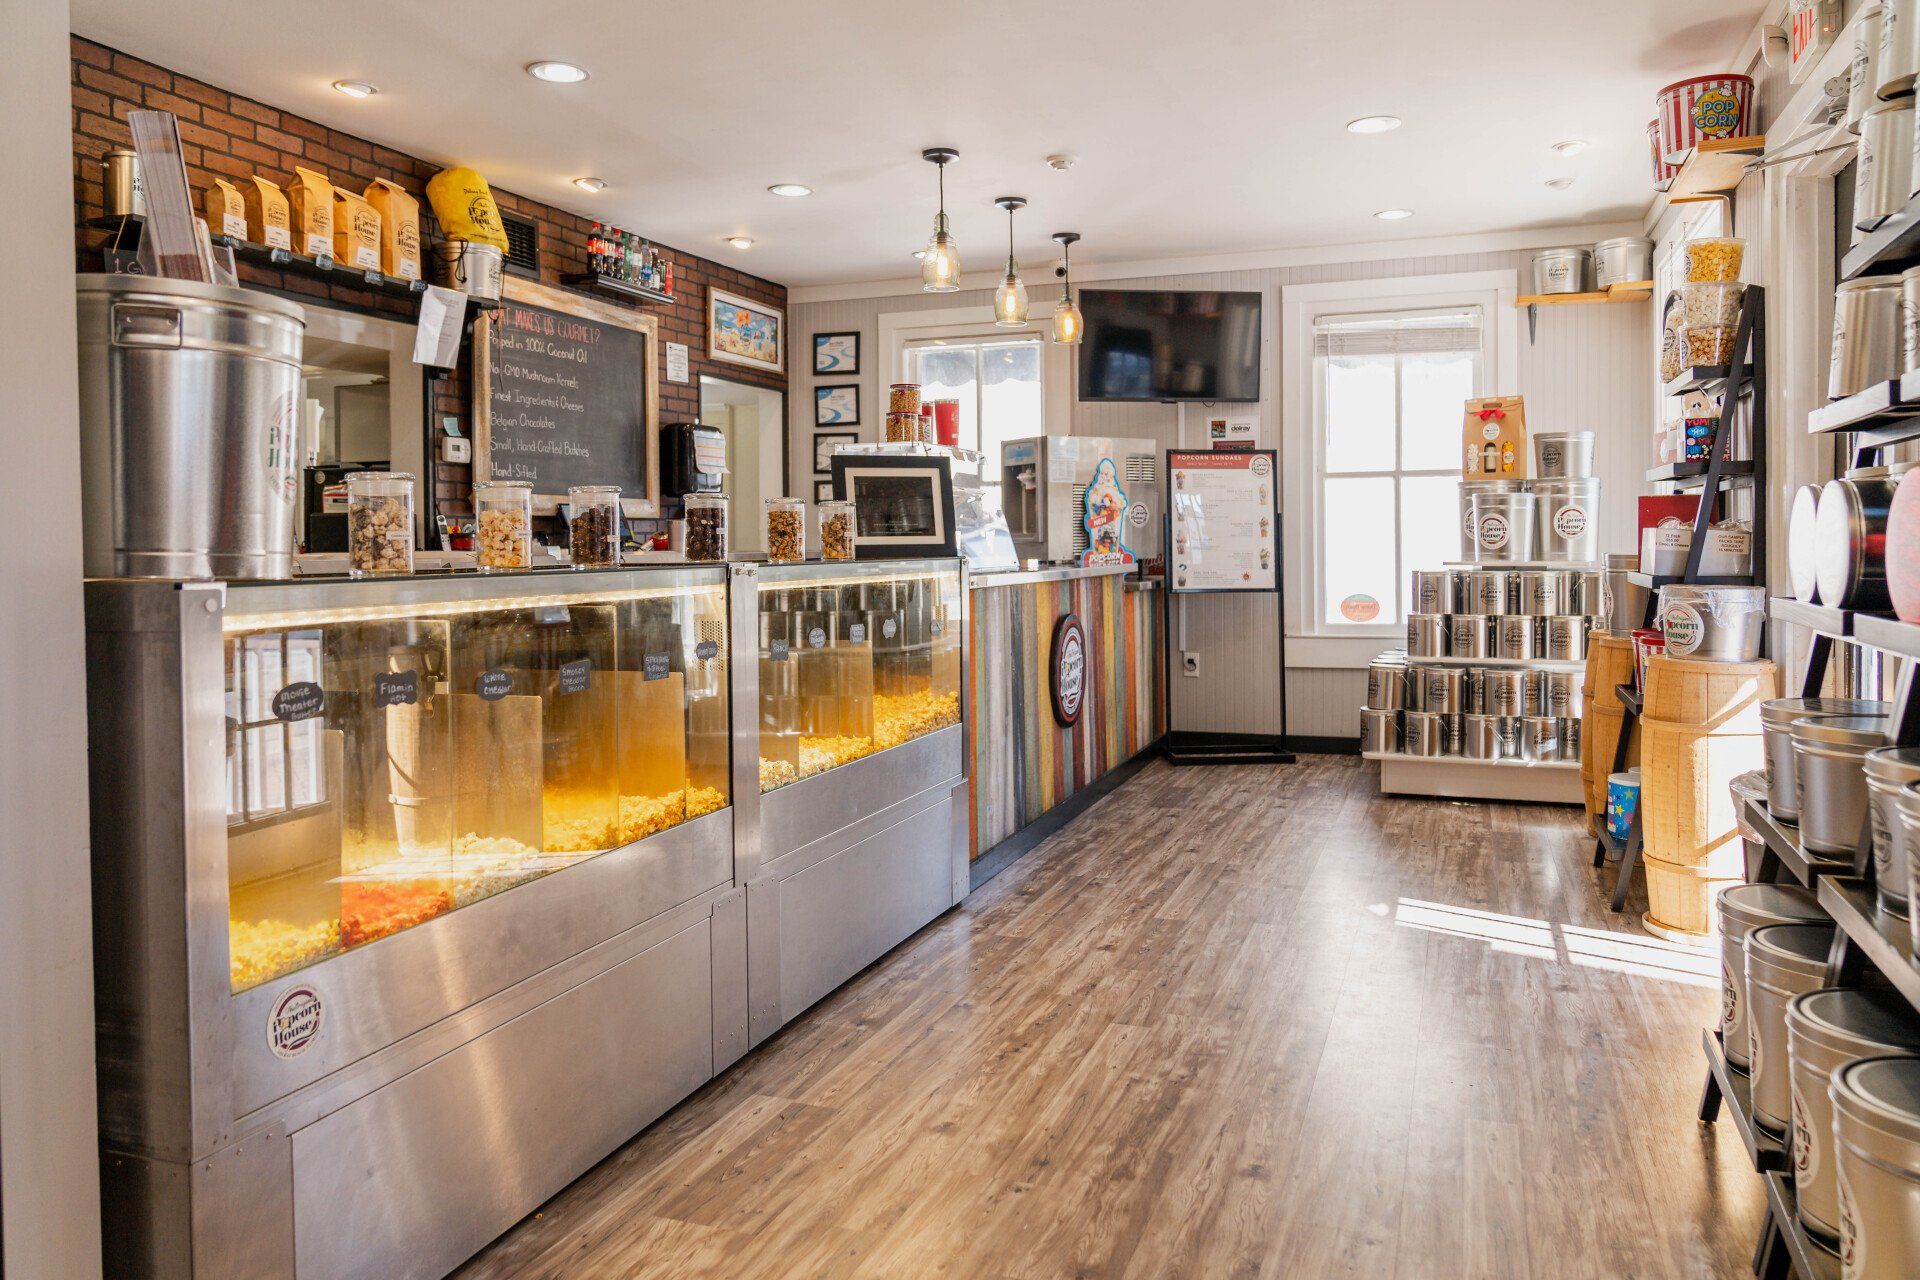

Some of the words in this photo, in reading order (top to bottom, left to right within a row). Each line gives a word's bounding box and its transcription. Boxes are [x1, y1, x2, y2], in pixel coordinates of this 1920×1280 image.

[1793, 8, 1814, 64] EXIT
[1702, 100, 1734, 114] POP
[1694, 114, 1738, 129] CORN
[515, 309, 540, 333] MAKES
[543, 315, 555, 336] US
[557, 320, 600, 344] GOURMET?
[489, 329, 514, 349] Popped
[515, 341, 523, 349] in
[525, 338, 545, 353] 100%
[547, 343, 575, 360] Coconut
[576, 349, 588, 363] Oil
[489, 362, 520, 378] No-GMO
[522, 368, 556, 384] Mushroom
[557, 373, 579, 389] Kernels
[490, 387, 511, 402] Finest
[515, 389, 555, 408] Ingredients
[560, 395, 584, 412] Cheeses
[490, 411, 517, 431] Belgian
[520, 413, 556, 429] Chocolates
[490, 436, 515, 453] Small,
[564, 441, 590, 458] Batches
[281, 686, 311, 702] Movie
[380, 683, 414, 695] Flamin
[279, 698, 318, 713] Theater
[275, 1020, 312, 1048] House
